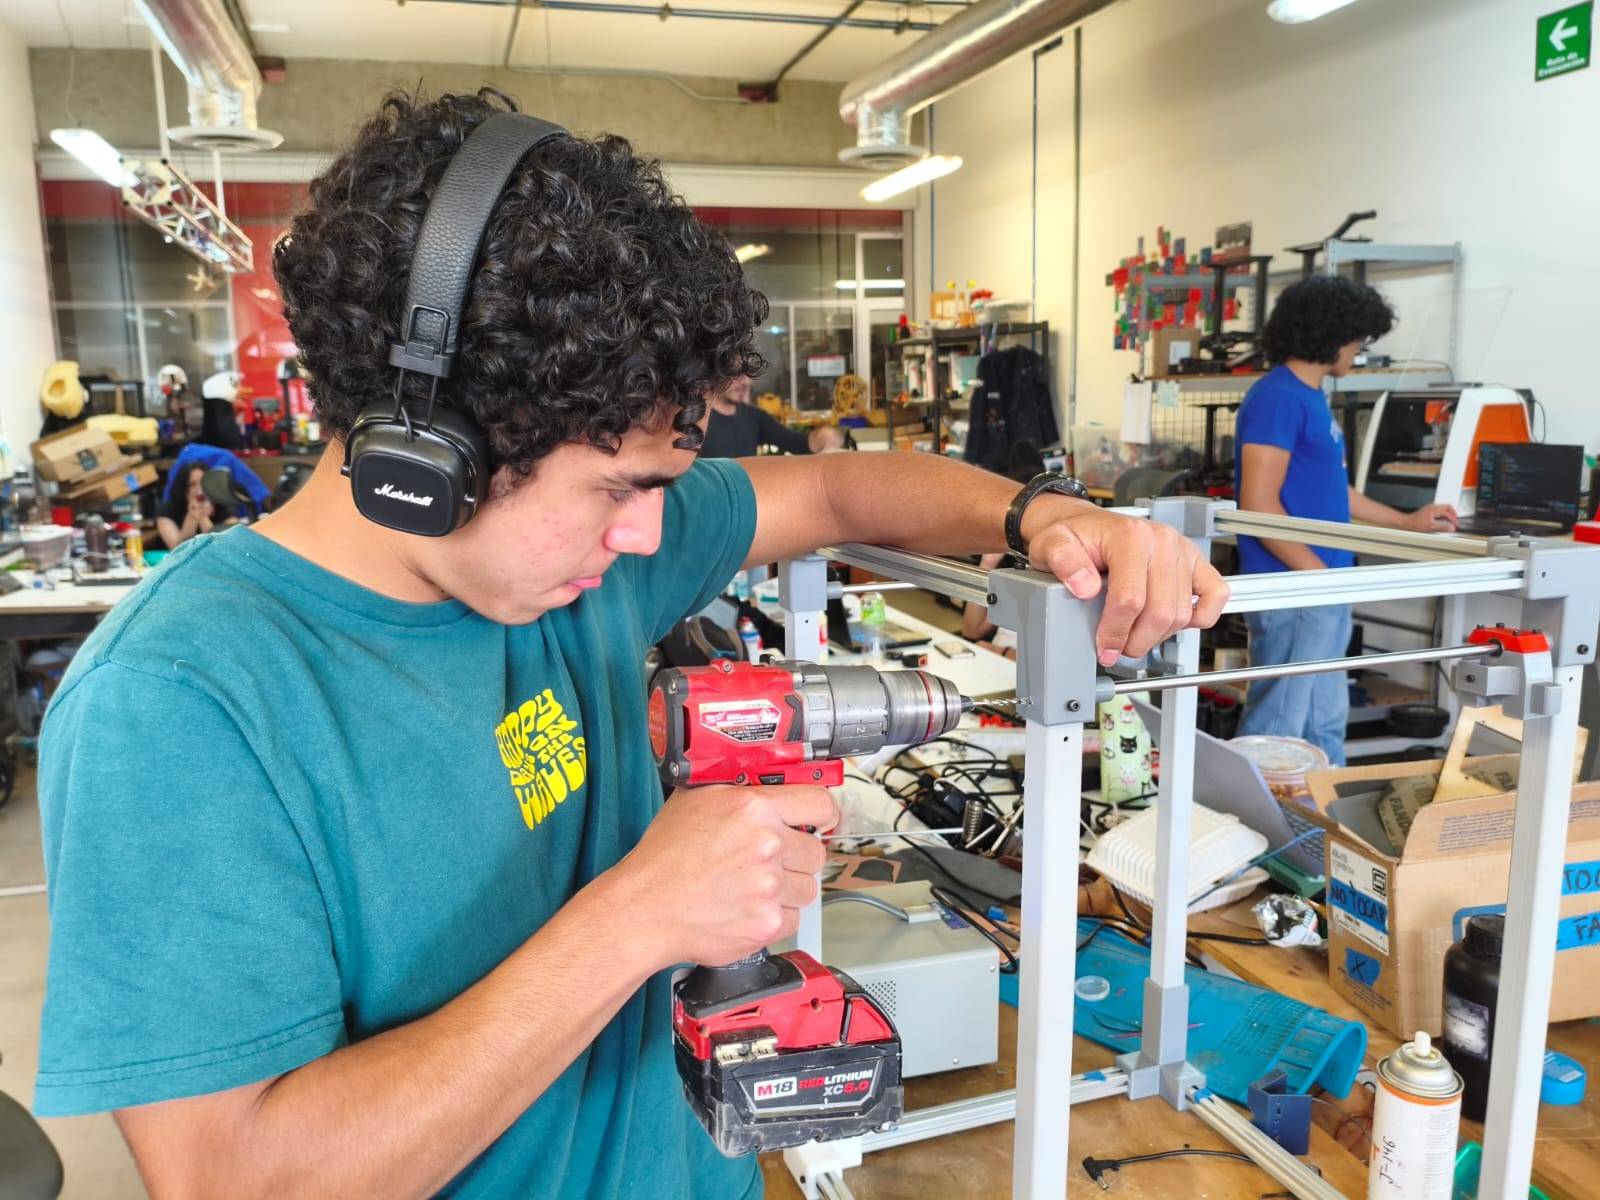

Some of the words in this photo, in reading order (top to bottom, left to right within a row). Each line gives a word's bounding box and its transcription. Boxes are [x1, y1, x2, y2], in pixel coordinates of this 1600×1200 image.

[374, 484, 433, 506] Marshall
[495, 689, 563, 768] HAPPY
[530, 714, 577, 752] ON
[537, 733, 573, 764] THE
[514, 736, 587, 831] WAVES
[1331, 884, 1347, 904] NO
[757, 1080, 794, 1097] M18
[800, 1069, 873, 1089] REDLITHIUM
